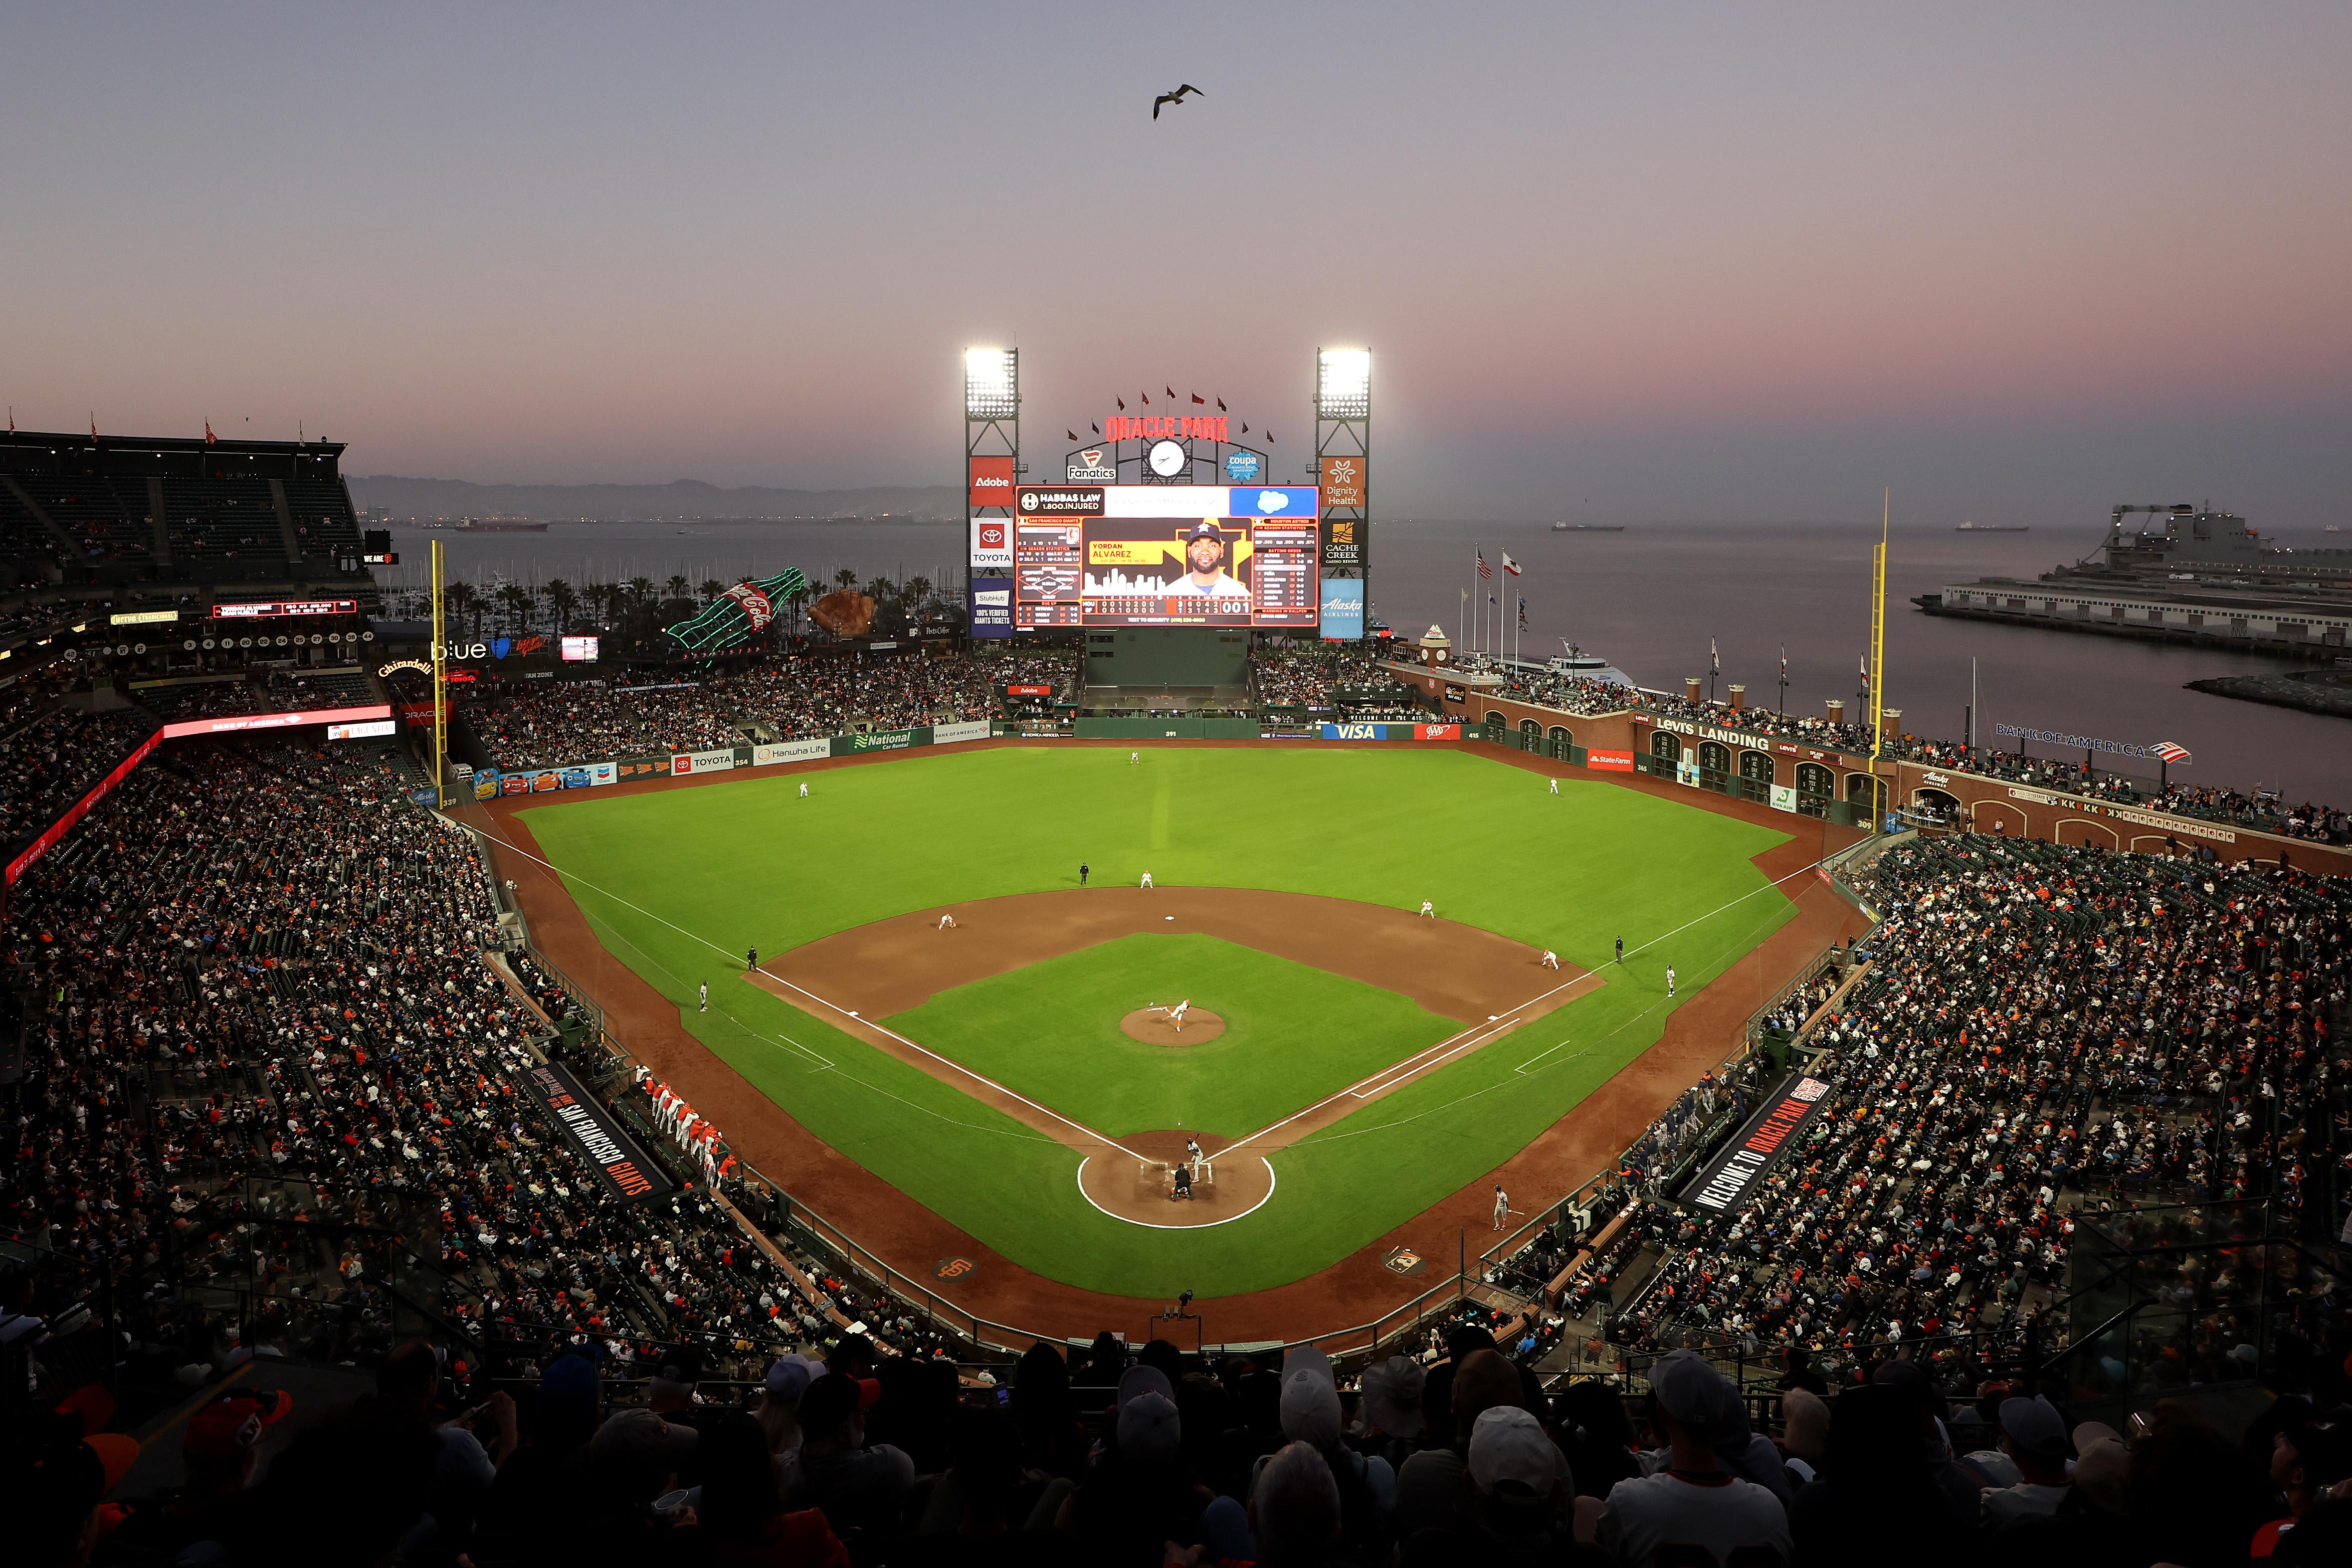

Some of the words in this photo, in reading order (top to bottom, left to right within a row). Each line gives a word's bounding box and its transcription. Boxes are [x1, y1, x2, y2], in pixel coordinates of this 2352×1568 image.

[1106, 416, 1175, 442] ORACLE
[1180, 416, 1229, 443] PARK
[1229, 456, 1257, 466] coupa
[1069, 467, 1115, 479] Fanatics
[975, 477, 1009, 487] Adobe
[1327, 486, 1358, 497] Dignity
[1040, 494, 1079, 502] HABBAS
[1080, 494, 1101, 502] LAW
[1321, 598, 1363, 610] Alaska
[378, 658, 433, 677] Ghirardelli
[1451, 688, 1465, 697] Sports
[248, 719, 285, 728] AMERICA
[352, 725, 394, 735] LAGUNITAS
[1335, 725, 1375, 739] VISA
[868, 732, 911, 746] National
[1699, 726, 1769, 751] LANDING
[1996, 724, 2038, 741] BANK
[2042, 731, 2063, 744] OF
[2066, 735, 2146, 758] AMERICA
[773, 748, 808, 758] Hanwha
[810, 745, 826, 754] Life
[694, 756, 731, 767] TOYOTA
[1922, 772, 1949, 784] Alaska
[414, 791, 435, 801] Alaska
[443, 798, 456, 806] 339
[1857, 820, 1872, 829] 309
[557, 1104, 588, 1127] SAN
[1771, 1098, 1811, 1123] PARK
[570, 1118, 625, 1164] FRANCISCO
[1745, 1119, 1794, 1154] ORACLE
[1733, 1150, 1766, 1166] TO
[606, 1162, 653, 1196] GIANTS
[1695, 1162, 1757, 1209] WELCOME
